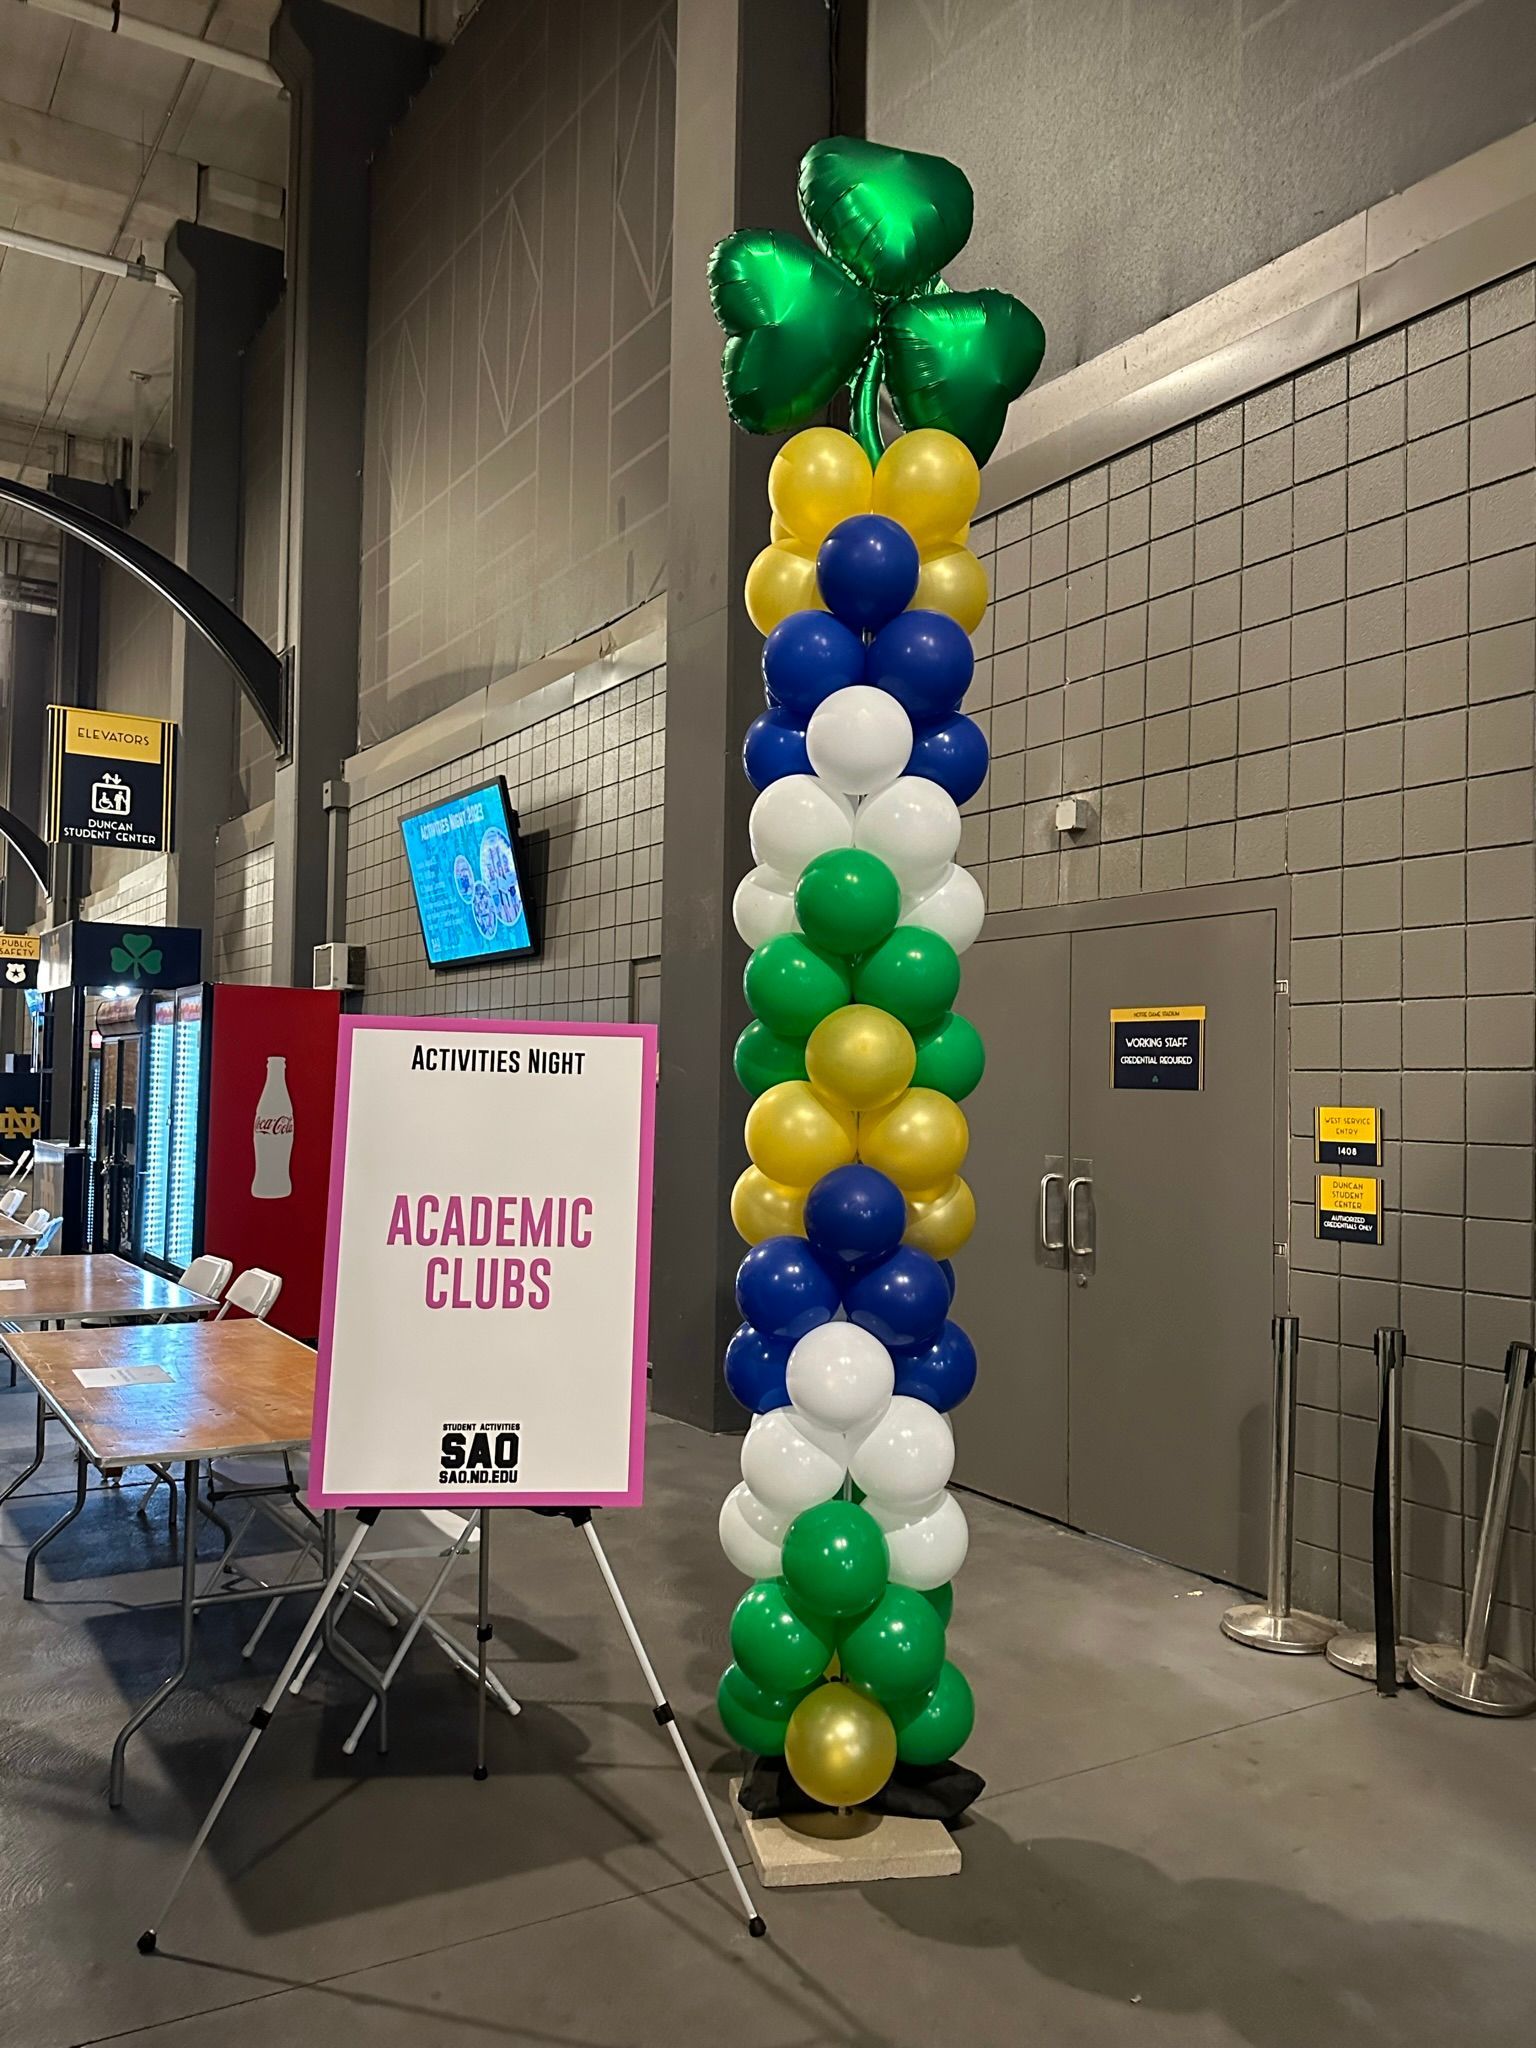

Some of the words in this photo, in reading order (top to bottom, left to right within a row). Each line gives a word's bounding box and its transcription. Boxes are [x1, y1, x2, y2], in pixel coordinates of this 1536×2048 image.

[77, 727, 150, 746] ELEVATORS
[88, 819, 133, 832] DUNCAN
[63, 827, 111, 840] STUDENT
[115, 832, 156, 845] CENTER
[2, 938, 33, 948] PUBLIC
[1125, 1037, 1163, 1048] WORKING
[1164, 1036, 1189, 1048] STAFF
[1120, 1056, 1158, 1065] CREDENTIAL
[1159, 1056, 1193, 1065] REQUIRED
[1343, 1117, 1370, 1125] SERVICE
[1337, 1146, 1357, 1156] 1408
[1332, 1181, 1364, 1190] DUNCAN
[1332, 1190, 1364, 1200] STUDENT
[1334, 1200, 1362, 1209] CENTER
[386, 1194, 593, 1248] ACADEMIC
[1331, 1215, 1365, 1224] AUTHORIZED
[1323, 1220, 1357, 1230] CREDENTIALS
[1358, 1224, 1373, 1232] ONLY
[425, 1256, 551, 1310] CLUBS
[442, 1423, 477, 1431] STUDENT
[479, 1423, 521, 1431] ACTIVITIES
[440, 1432, 519, 1469] SAO
[439, 1470, 518, 1484] SAO.ND.EDU
